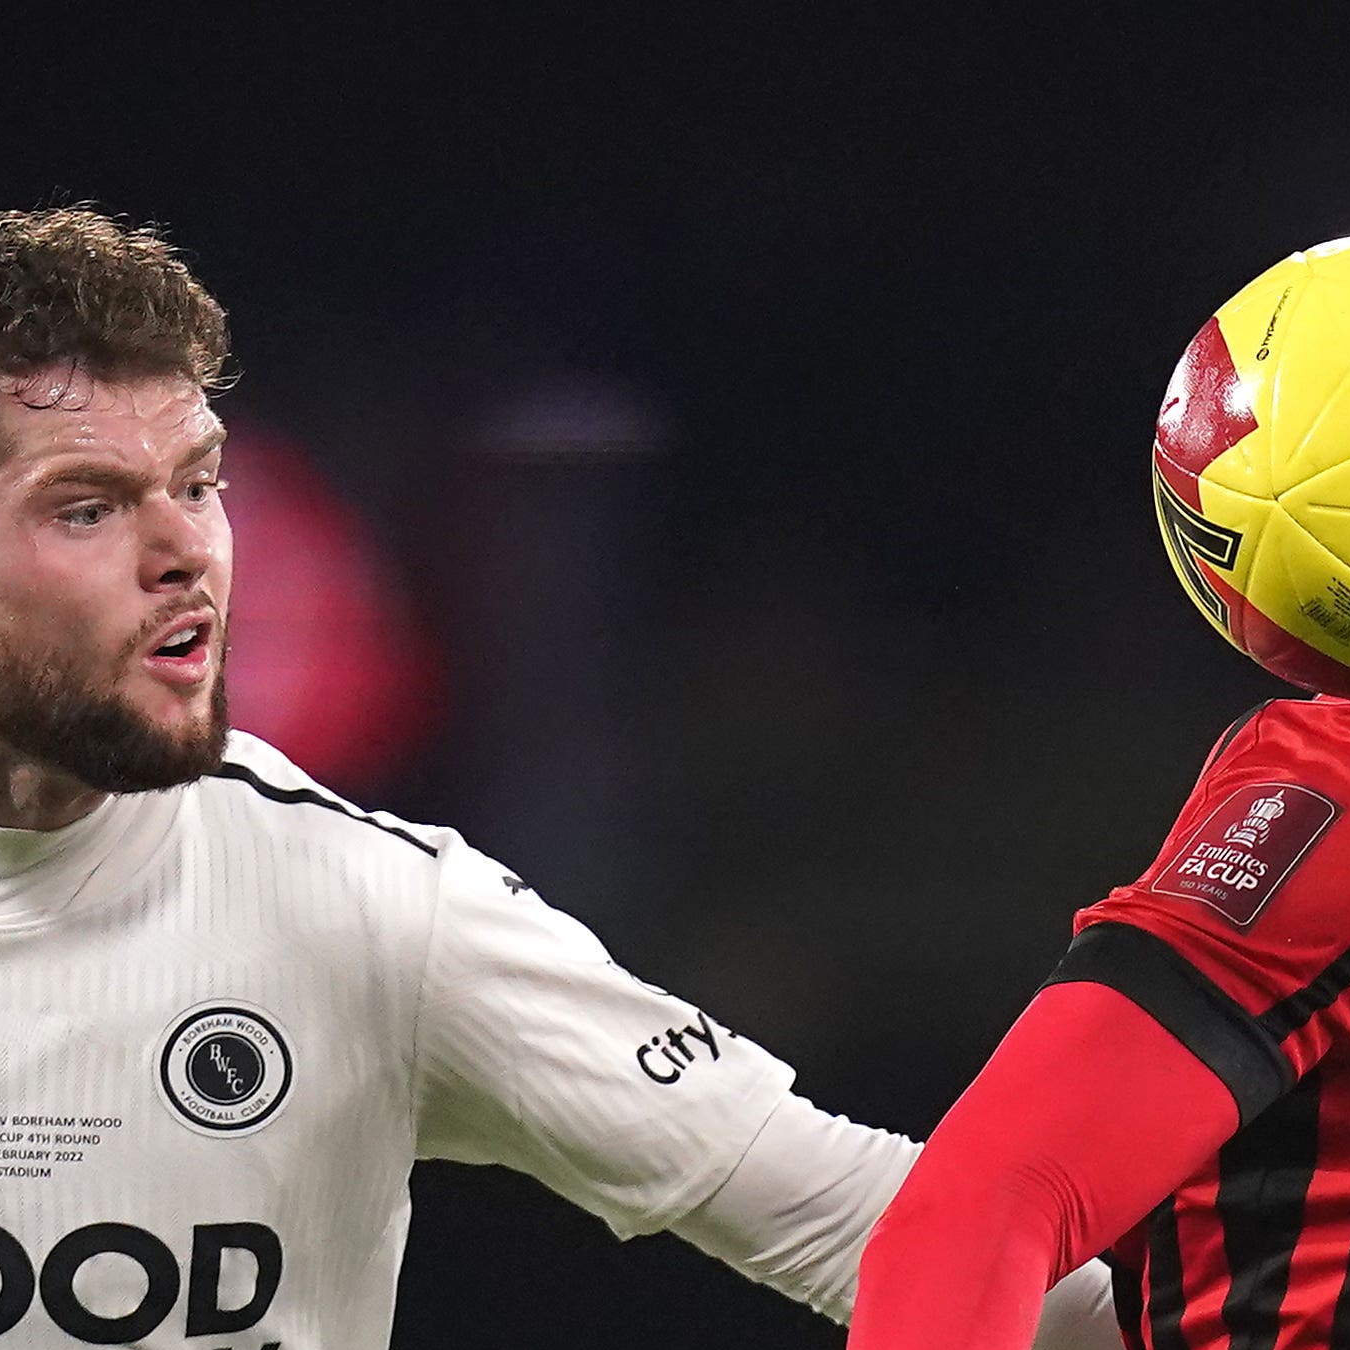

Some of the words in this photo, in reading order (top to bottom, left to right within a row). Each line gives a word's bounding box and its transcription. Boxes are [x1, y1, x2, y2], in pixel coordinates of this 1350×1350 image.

[1192, 842, 1268, 876] Emirates
[1178, 858, 1206, 876] FA
[1206, 862, 1258, 891] CUP
[1196, 882, 1228, 900] YEARS
[182, 1018, 233, 1045] BOREHAM
[236, 1019, 269, 1046] WOOD
[636, 1011, 721, 1085] City
[185, 1095, 236, 1120] FOOTBALL
[240, 1097, 267, 1118] CLUB
[0, 1115, 8, 1126] V
[12, 1116, 75, 1127] BOREHAM
[80, 1117, 122, 1128] WOOD
[0, 1132, 23, 1143] CUP
[27, 1133, 51, 1144] 4TH
[55, 1134, 101, 1145] ROUND
[55, 1151, 84, 1162] 2022
